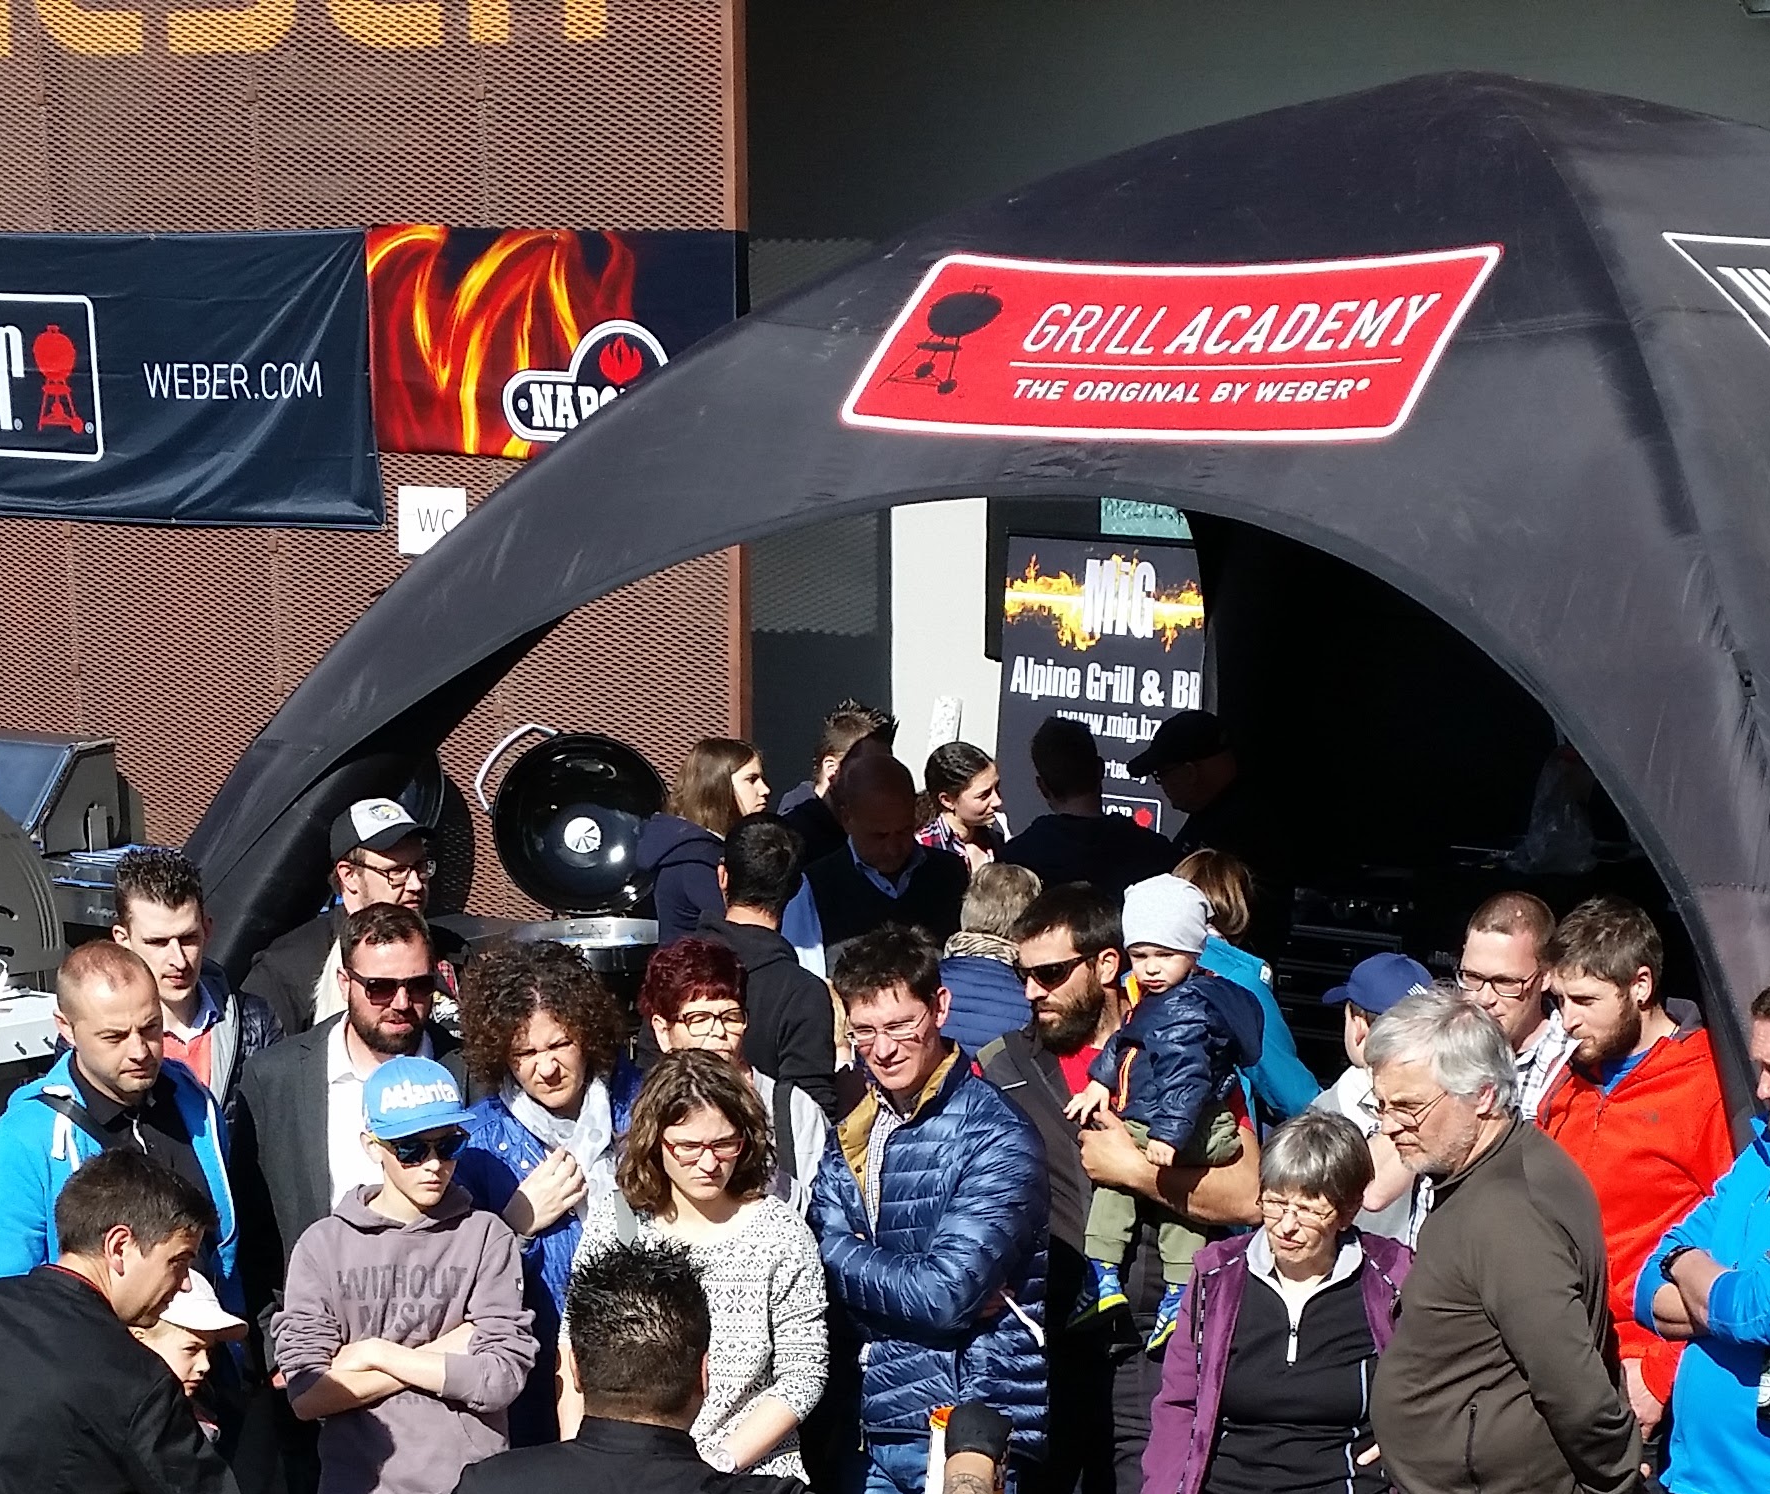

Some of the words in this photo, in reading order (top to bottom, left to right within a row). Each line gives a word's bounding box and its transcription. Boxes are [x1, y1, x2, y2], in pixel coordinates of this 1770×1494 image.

[1022, 303, 1168, 355] GRILL
[1163, 292, 1442, 356] ACADEMY
[142, 360, 324, 401] WEBER.COM
[1013, 378, 1069, 401] THE
[1072, 380, 1200, 403] ORIGINAL
[1210, 382, 1254, 404] BY
[1009, 655, 1082, 701] Alpine
[1085, 661, 1135, 705] Grill
[1140, 669, 1165, 708] &
[337, 1264, 467, 1301] WITHOUT
